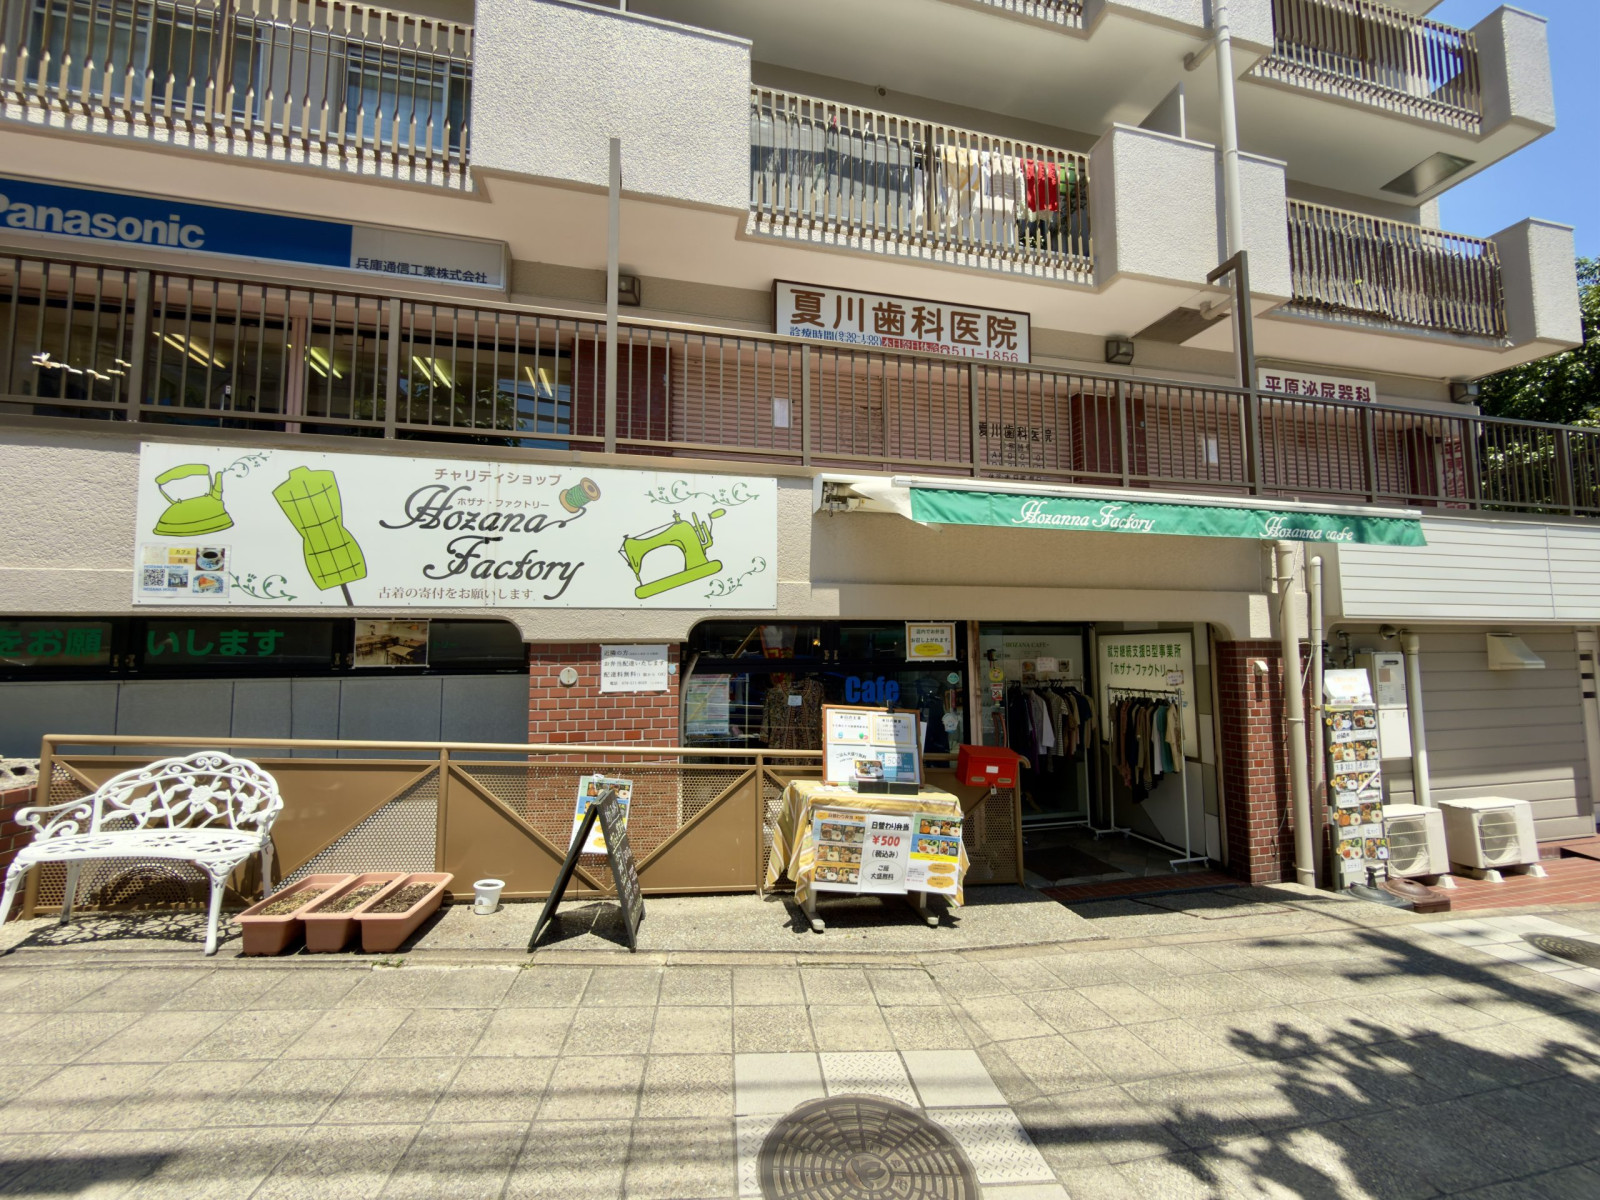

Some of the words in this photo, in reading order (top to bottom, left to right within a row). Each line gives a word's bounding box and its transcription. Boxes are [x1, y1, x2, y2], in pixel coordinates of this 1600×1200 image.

[355, 257, 488, 284] 兵庫通信工業株式会社
[790, 288, 1018, 351] 夏川歯科医院
[1265, 375, 1371, 403] 平原泌尿器科
[434, 467, 563, 487] チャリティショップ
[378, 484, 567, 535] Hozana
[457, 497, 551, 510] ホザナ・ファクトリー
[1011, 499, 1091, 527] Hozanna
[1092, 505, 1156, 533] Factory
[1259, 516, 1323, 540] Hozanna
[422, 535, 585, 601] Factory
[146, 628, 285, 657] いします
[844, 675, 900, 704] Cafe
[871, 820, 910, 832] 日替わり弁当
[872, 835, 901, 847] ¥500
